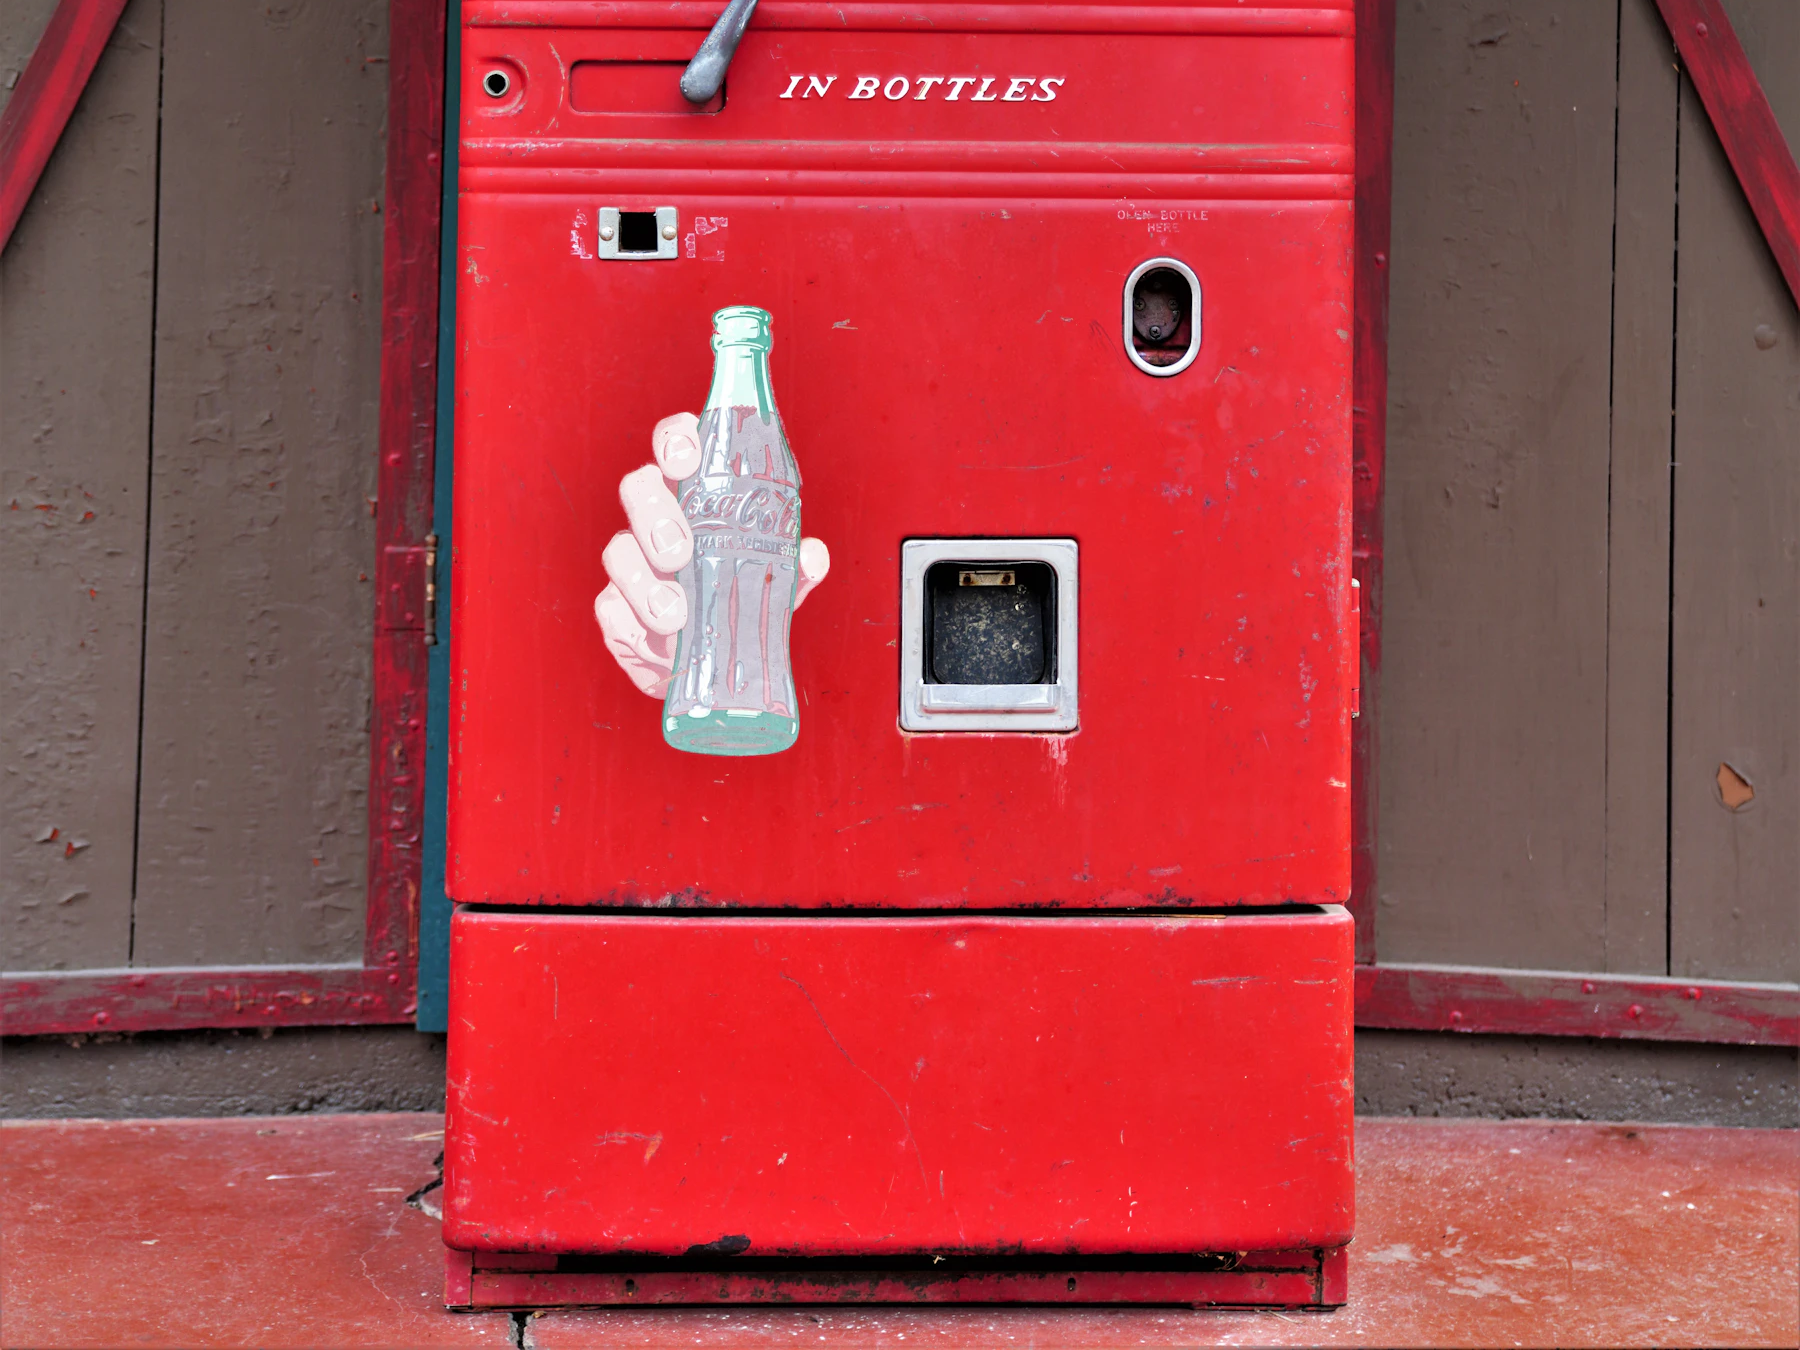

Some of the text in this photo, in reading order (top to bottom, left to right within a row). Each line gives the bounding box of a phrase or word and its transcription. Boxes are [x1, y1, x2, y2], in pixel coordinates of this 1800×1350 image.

[719, 4, 735, 27] DOWN
[779, 74, 1065, 102] IN BOTTLES
[1160, 209, 1209, 221] BOTTLE
[1147, 222, 1180, 233] HERE
